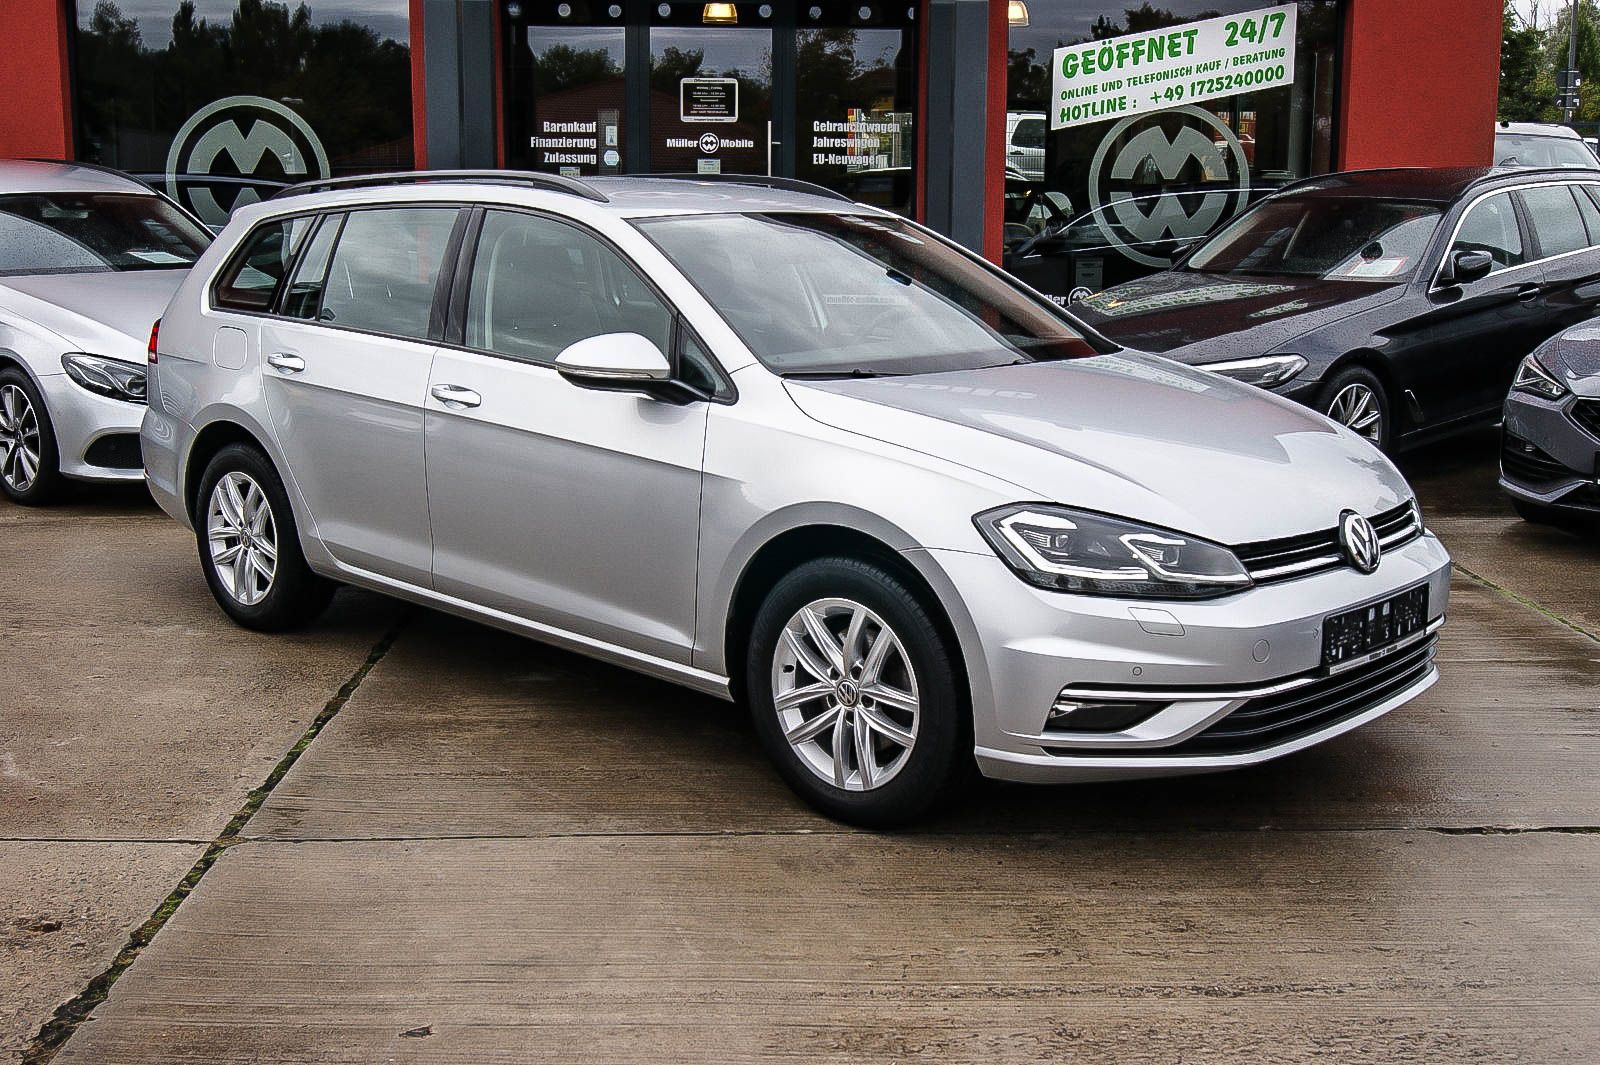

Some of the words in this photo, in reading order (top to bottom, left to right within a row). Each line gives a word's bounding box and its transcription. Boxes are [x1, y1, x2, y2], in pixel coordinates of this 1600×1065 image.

[1062, 29, 1198, 79] GEÖFFNET
[1224, 12, 1287, 47] 24/7
[1060, 84, 1098, 100] ONLINE
[1101, 79, 1123, 92] UND
[1126, 65, 1193, 88] TELEFONISCH
[1196, 59, 1222, 74] KAUF
[1232, 47, 1286, 67] BERATUNG
[1060, 95, 1127, 123] HOTLINE
[1150, 84, 1185, 104] +49
[1190, 64, 1285, 97] 1725240000
[543, 121, 597, 133] Barankauf
[813, 120, 900, 133] Gebrauchtwagen
[530, 136, 597, 149] Finanzierung
[666, 138, 699, 148] Müller
[720, 139, 754, 148] Mobile
[812, 136, 881, 149] Jahreswagen
[543, 151, 597, 164] Zulassung
